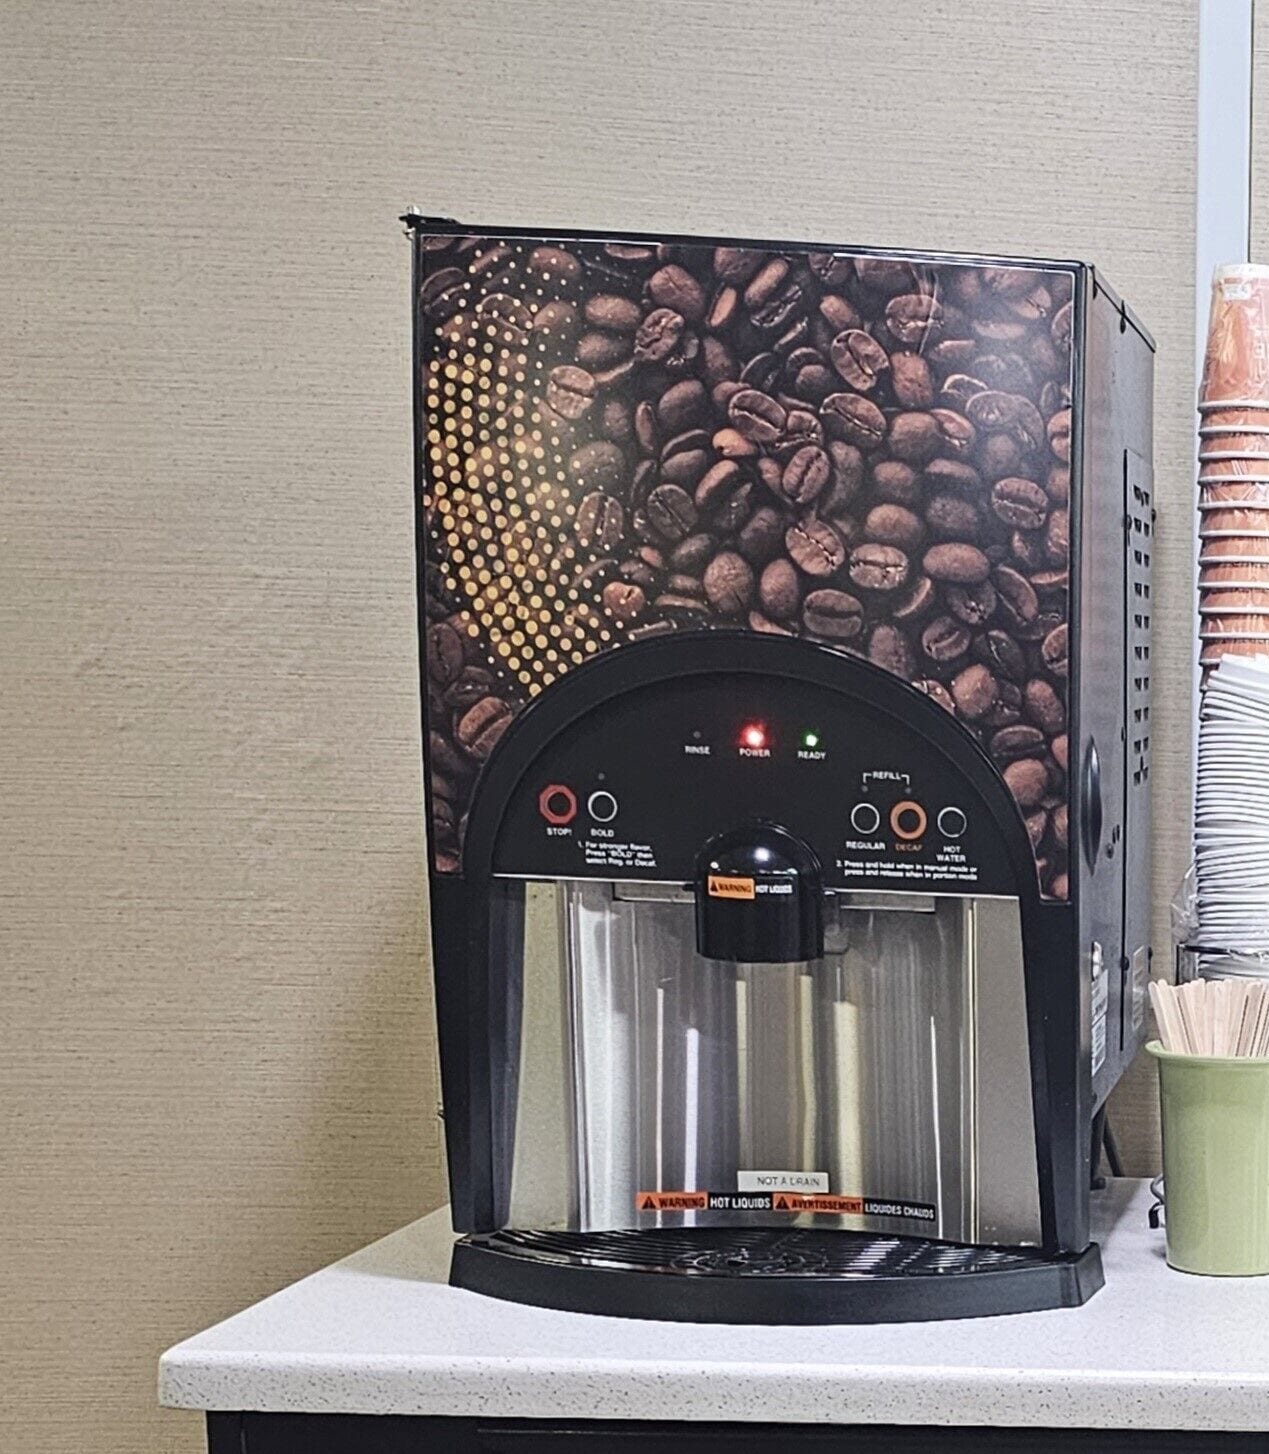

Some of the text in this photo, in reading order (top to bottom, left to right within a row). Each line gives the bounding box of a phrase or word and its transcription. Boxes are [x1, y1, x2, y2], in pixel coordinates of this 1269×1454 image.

[685, 746, 710, 755] RINSE
[739, 748, 770, 757] POWER
[798, 751, 826, 760] READY
[873, 772, 900, 780] REFILL
[547, 827, 572, 836] STOP!
[590, 829, 614, 837] BOLD
[846, 841, 886, 850] REGULAR
[937, 855, 966, 863] WATER
[757, 1176, 778, 1186] NOT
[781, 1177, 788, 1186] A
[658, 1197, 771, 1208] WARNING HOT LIQUIDS
[791, 1199, 935, 1219] AVERTISSEMENT LIQUIDES CHAUDS
